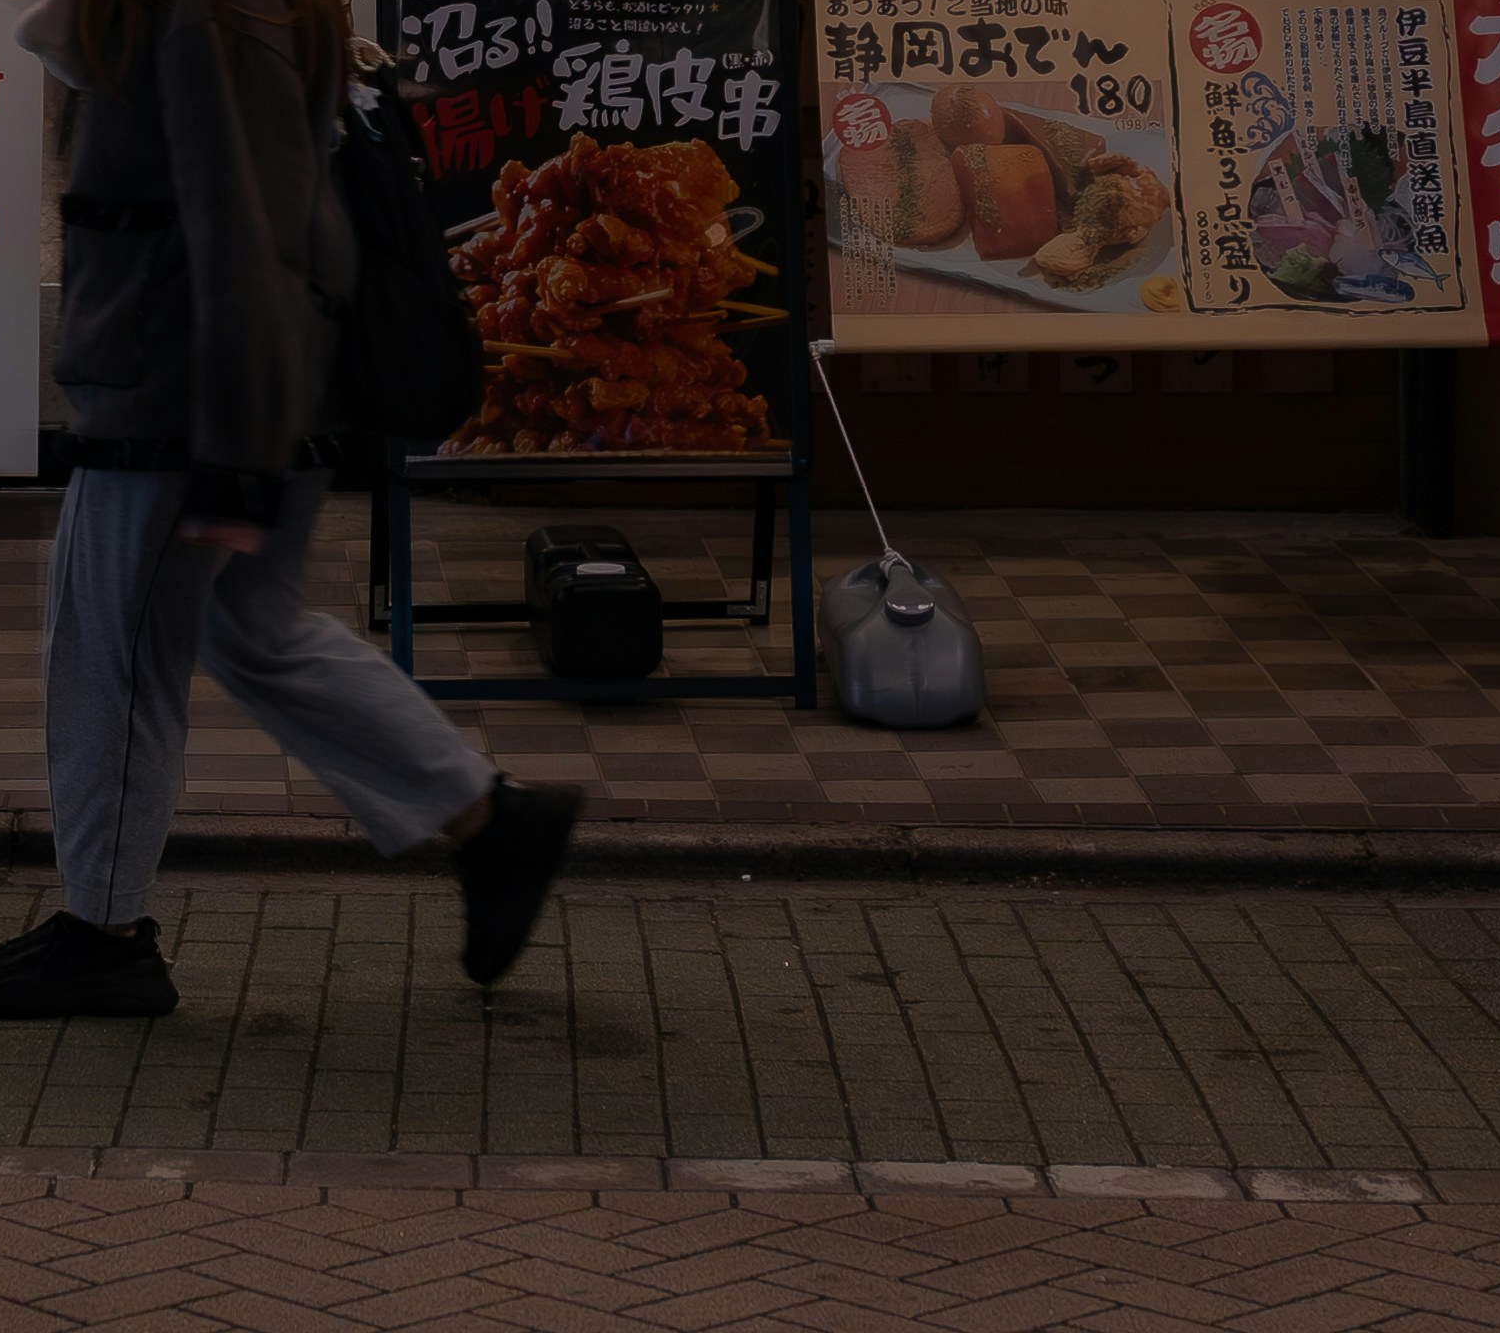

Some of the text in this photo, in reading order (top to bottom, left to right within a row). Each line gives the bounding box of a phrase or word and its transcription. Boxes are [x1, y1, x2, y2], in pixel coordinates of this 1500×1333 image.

[823, 17, 1130, 84] 静岡おでん
[1195, 9, 1259, 70] 名物
[411, 37, 782, 181] 揚げ鶏皮串
[836, 96, 890, 149] 名物
[1069, 73, 1154, 117] 180
[1395, 6, 1450, 256] 伊豆半島直送鮮魚
[1203, 80, 1258, 305] 鮮魚3点盛り
[1195, 210, 1213, 267] 888
